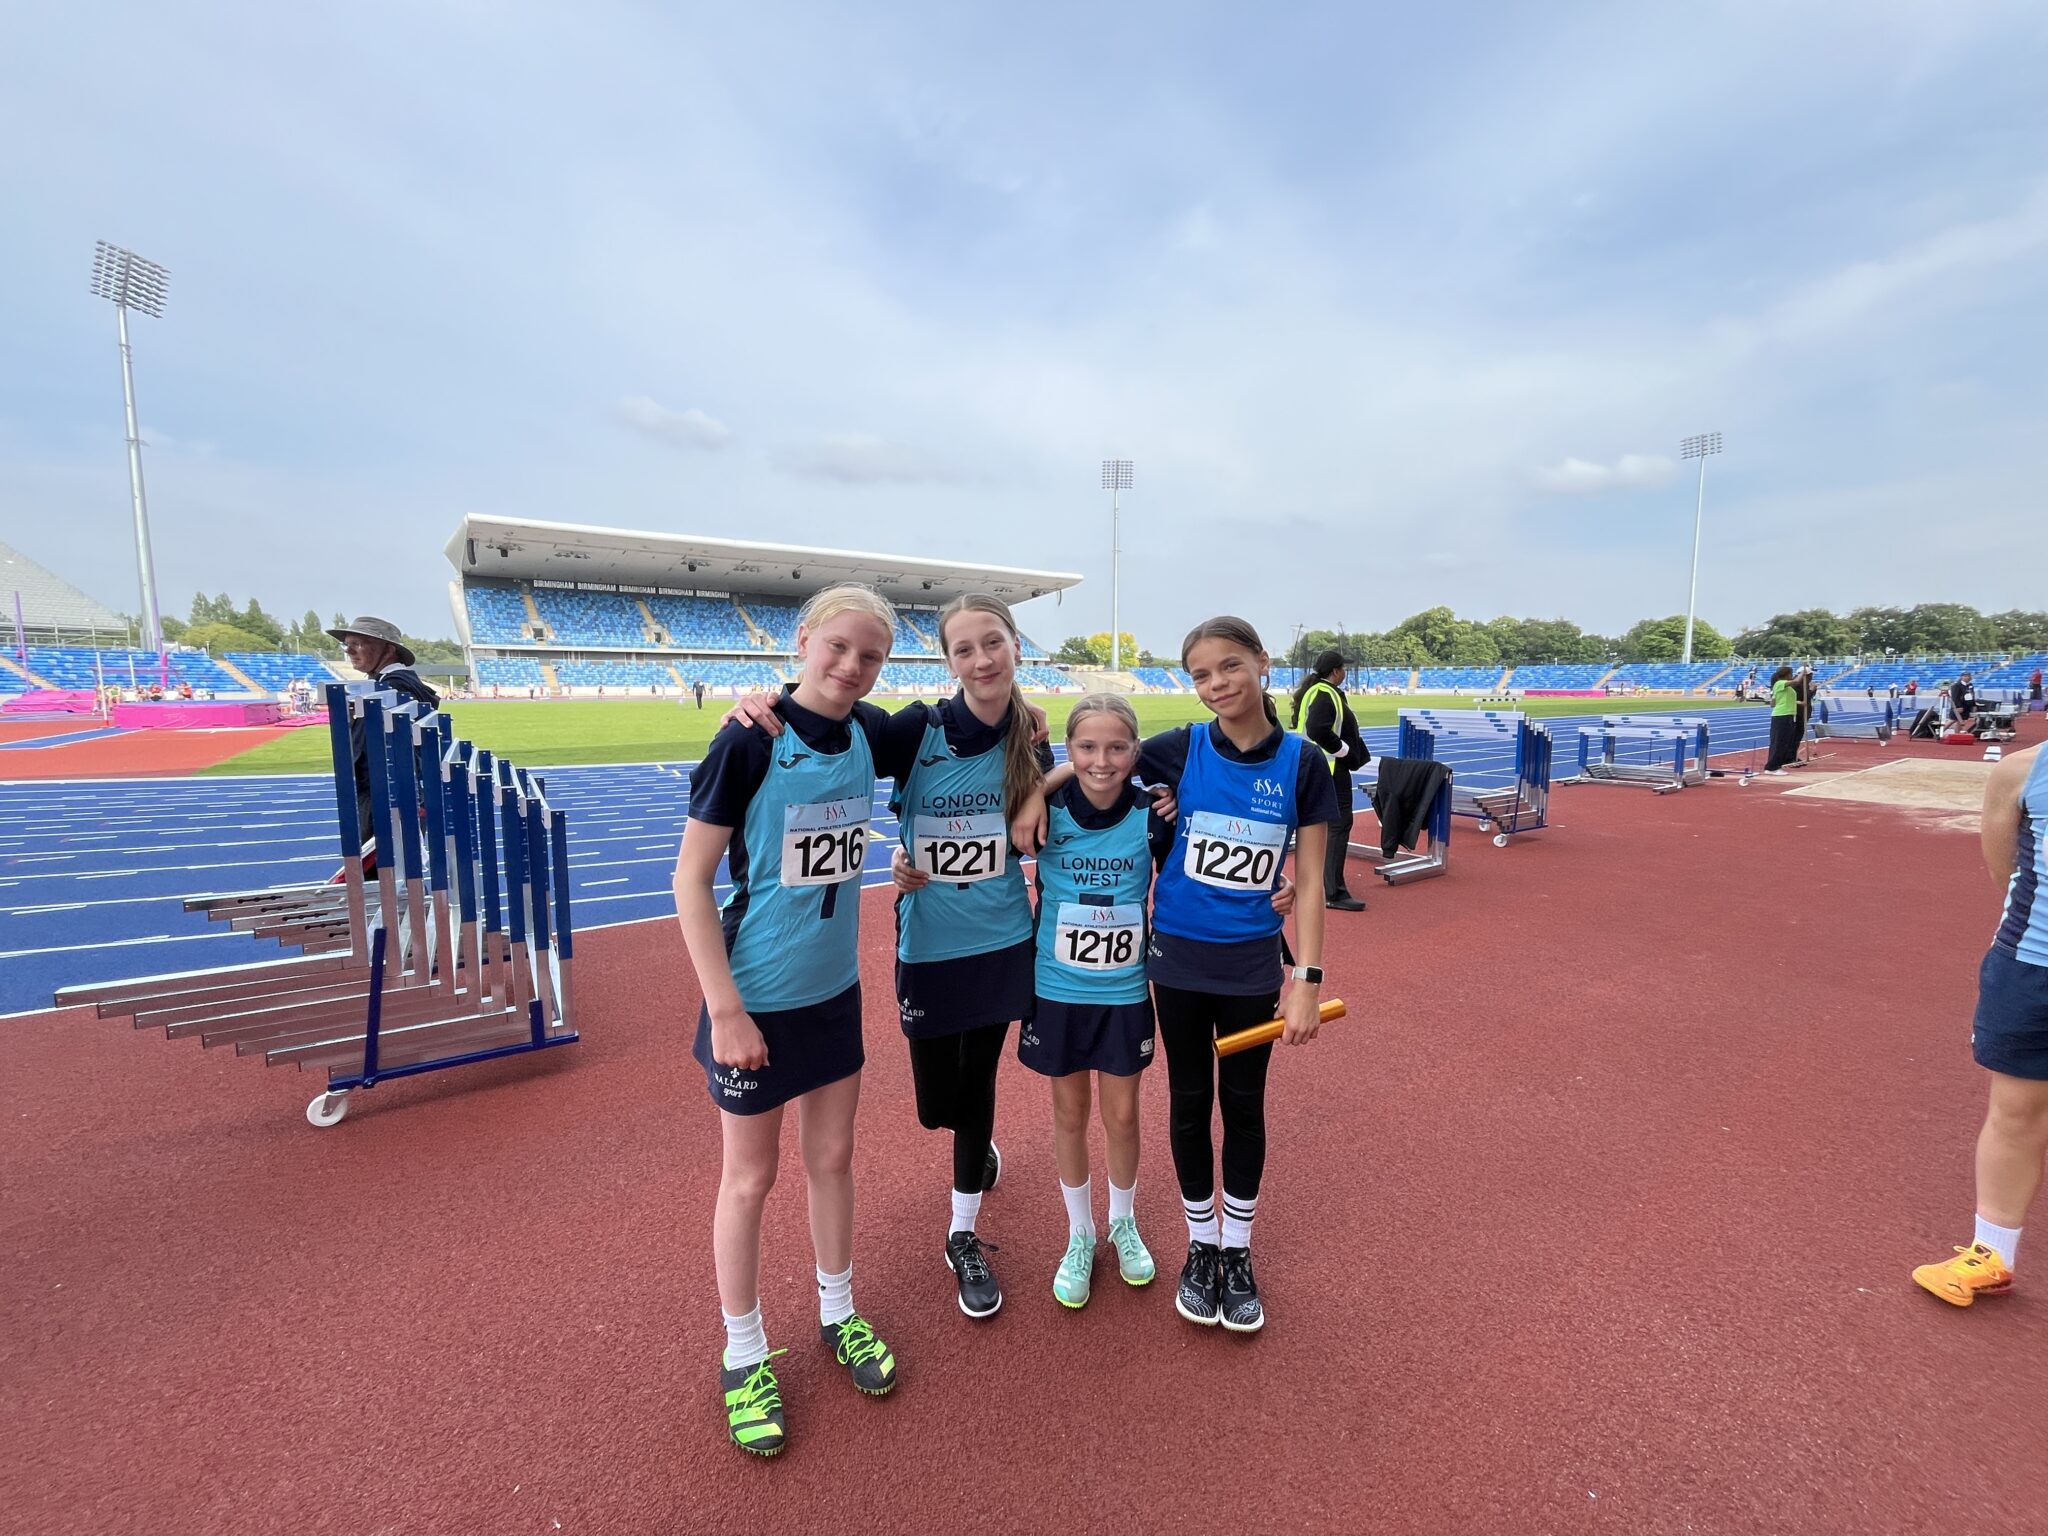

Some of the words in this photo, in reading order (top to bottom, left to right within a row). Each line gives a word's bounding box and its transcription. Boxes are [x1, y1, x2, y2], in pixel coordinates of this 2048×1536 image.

[533, 579, 575, 589] BIRMINGHAM
[577, 582, 617, 592] BIRMINGHAM
[618, 585, 656, 594] BIRMINGHAM
[658, 587, 694, 596] BIRMINGHAM
[696, 589, 730, 599] BIRMINGHAM
[921, 793, 1001, 809] LONDON
[1251, 797, 1283, 810] SPORT
[794, 827, 864, 877] 1216
[924, 839, 996, 876] 1221
[1061, 857, 1134, 871] LONDON
[1193, 838, 1274, 885] 1220
[1072, 873, 1122, 887] WEST
[1065, 929, 1133, 964] 1218
[723, 1087, 743, 1099] sport
